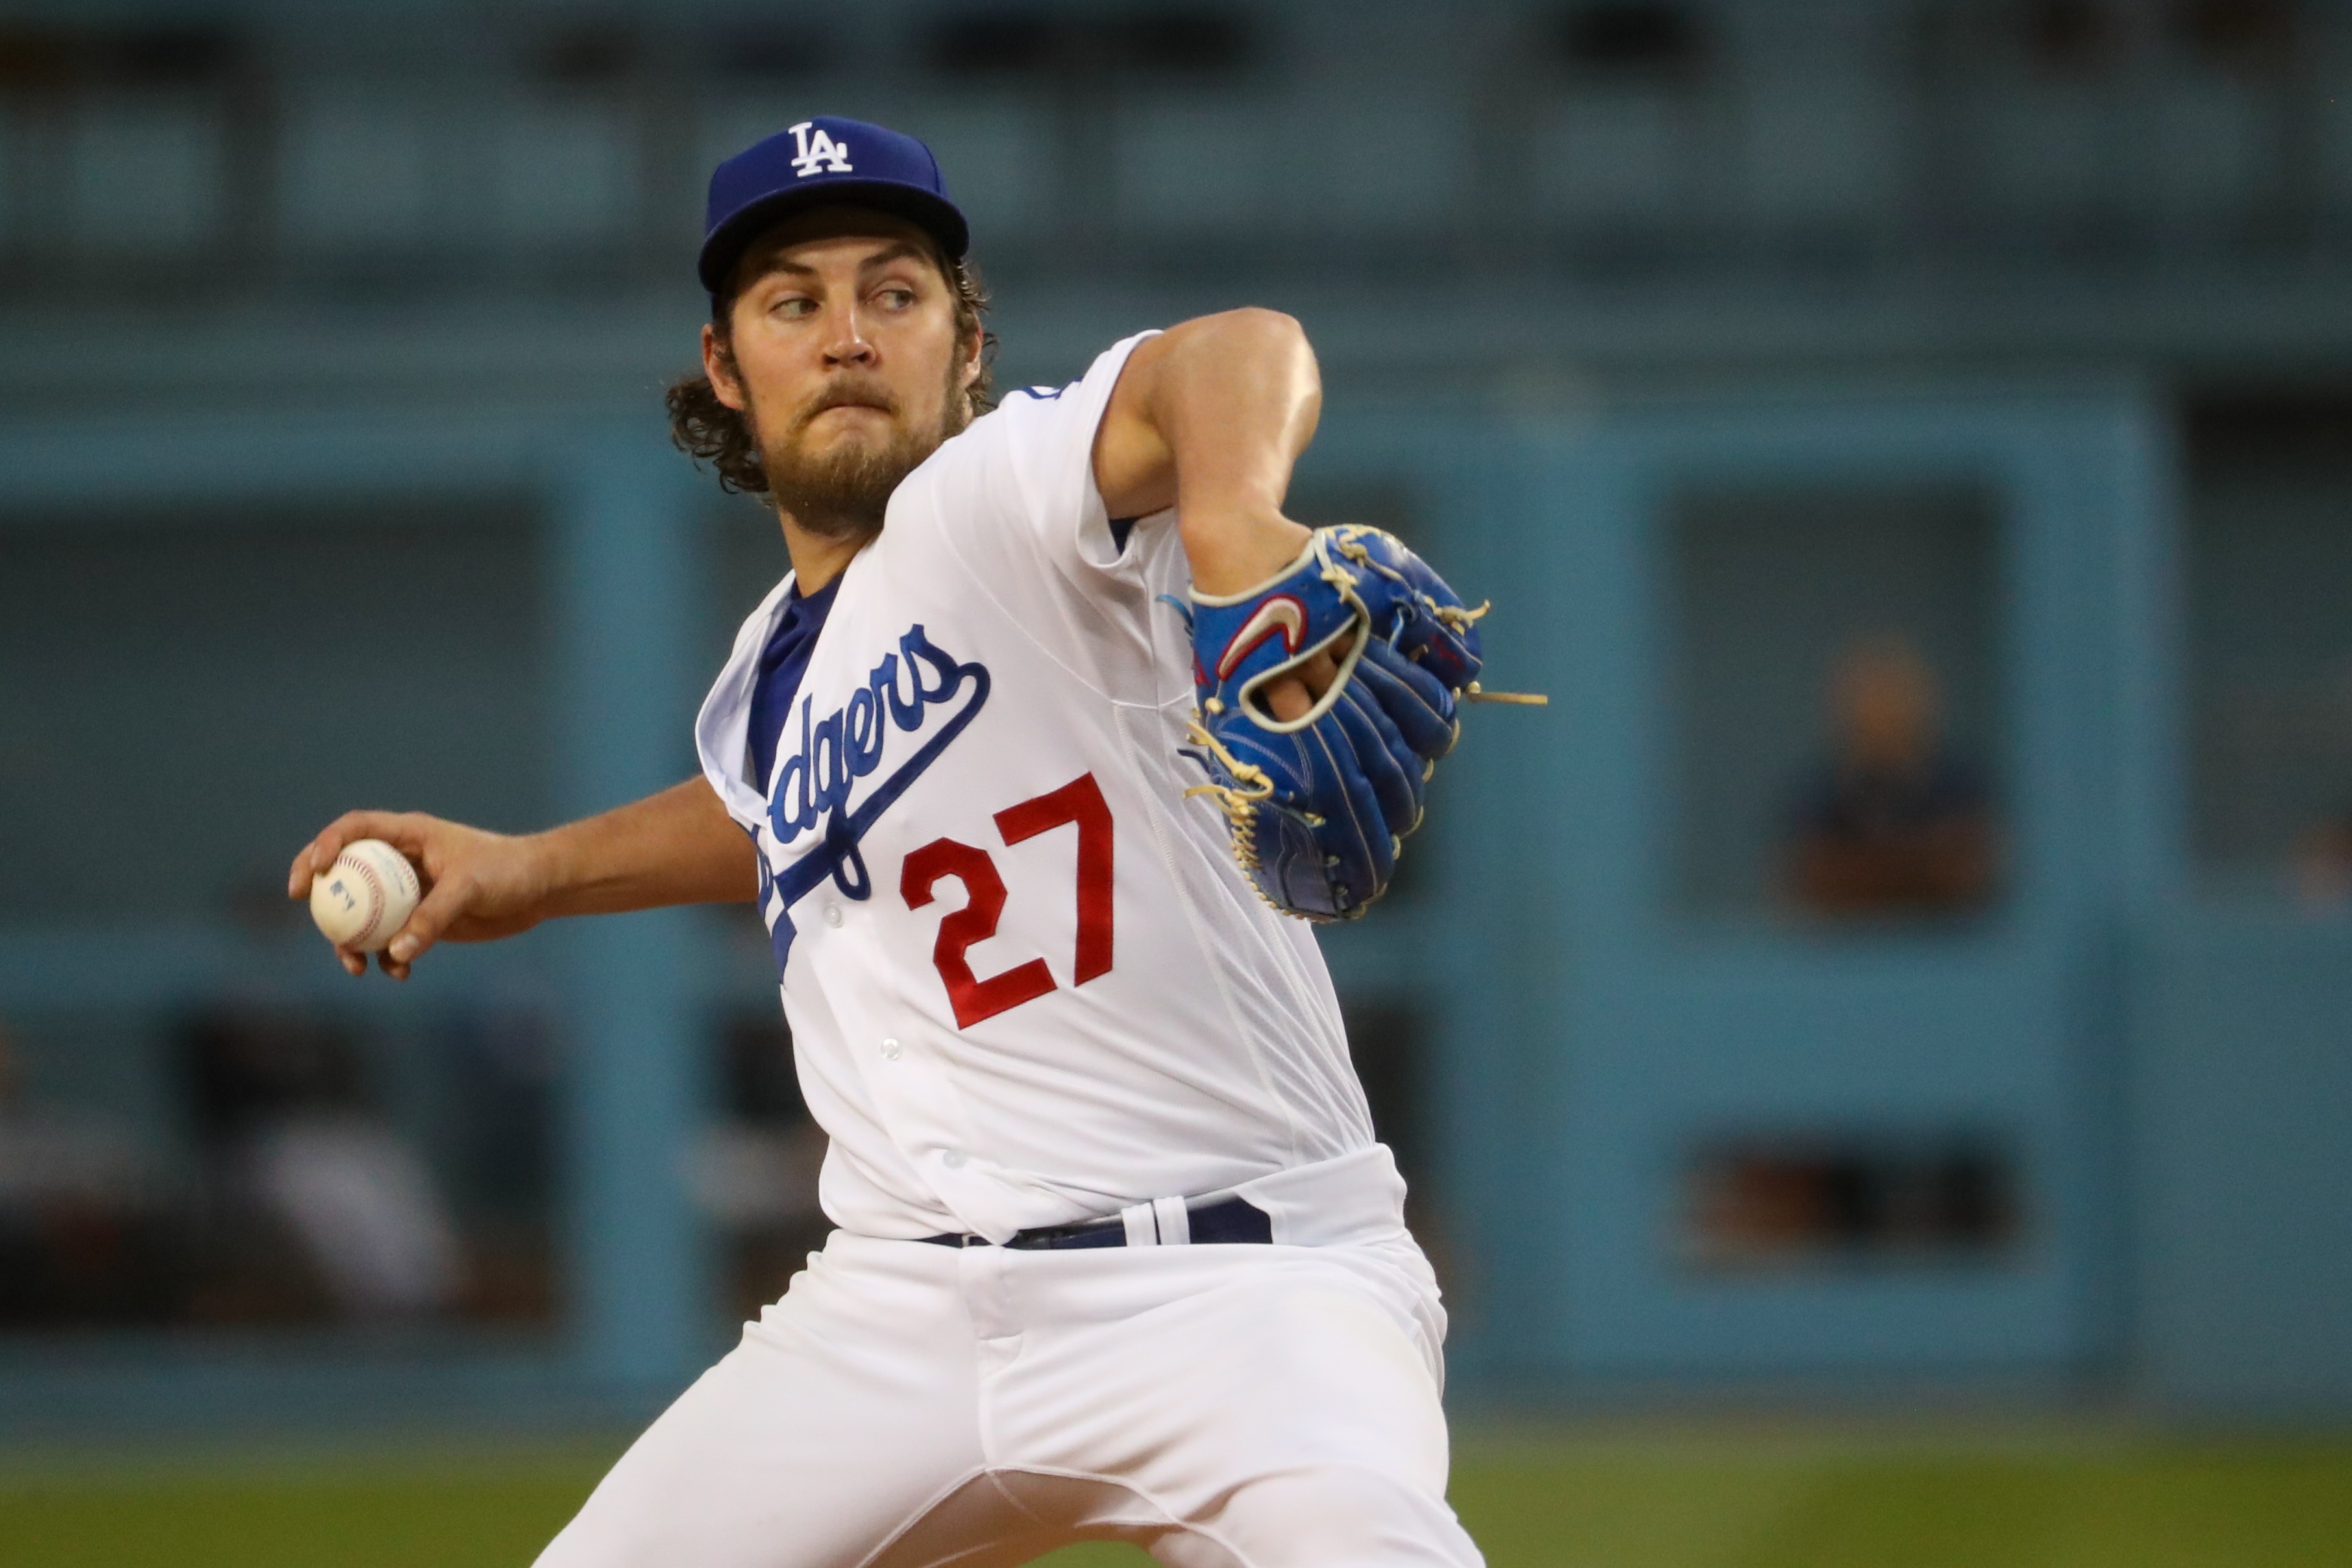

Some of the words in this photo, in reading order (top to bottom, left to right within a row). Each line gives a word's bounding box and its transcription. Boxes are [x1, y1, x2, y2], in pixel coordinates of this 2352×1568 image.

[788, 121, 853, 177] LA
[753, 623, 991, 920] dgers
[900, 771, 1114, 1030] 27
